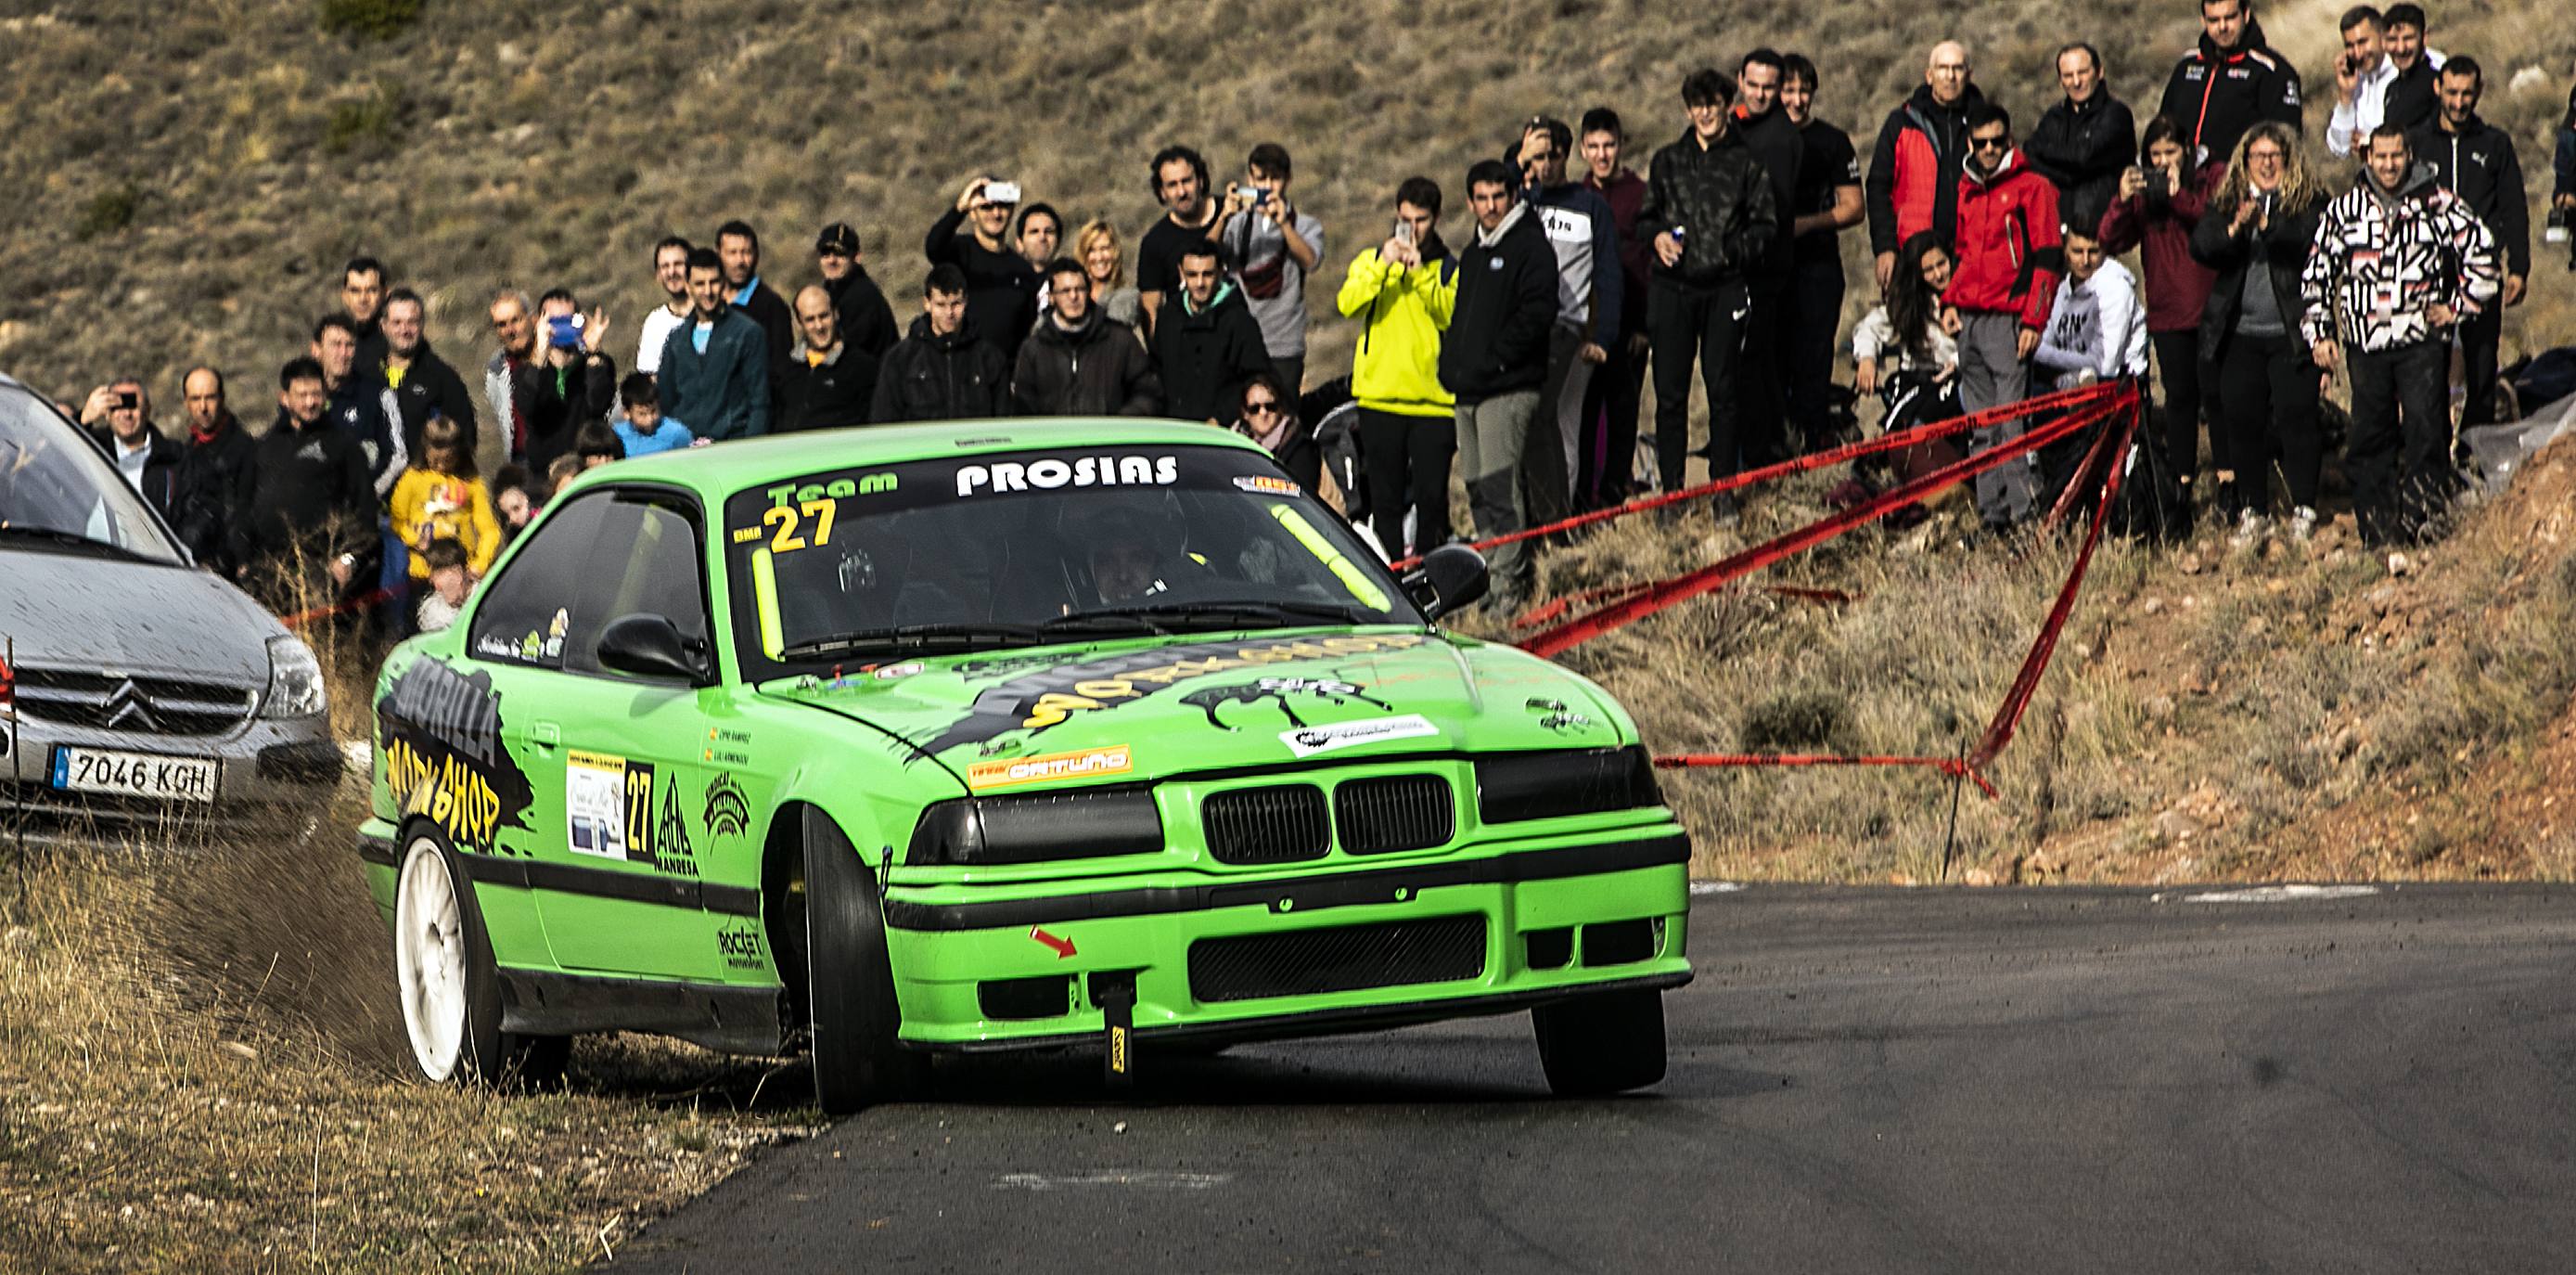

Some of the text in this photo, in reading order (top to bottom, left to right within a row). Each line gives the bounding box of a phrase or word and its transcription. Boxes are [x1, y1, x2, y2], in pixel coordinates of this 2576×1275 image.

[767, 471, 898, 508] Team
[956, 456, 1177, 497] PROSIAS
[763, 498, 836, 553] 27
[78, 754, 206, 793] 7046 KGH
[627, 769, 651, 853] 27
[654, 856, 699, 878] MANRESA
